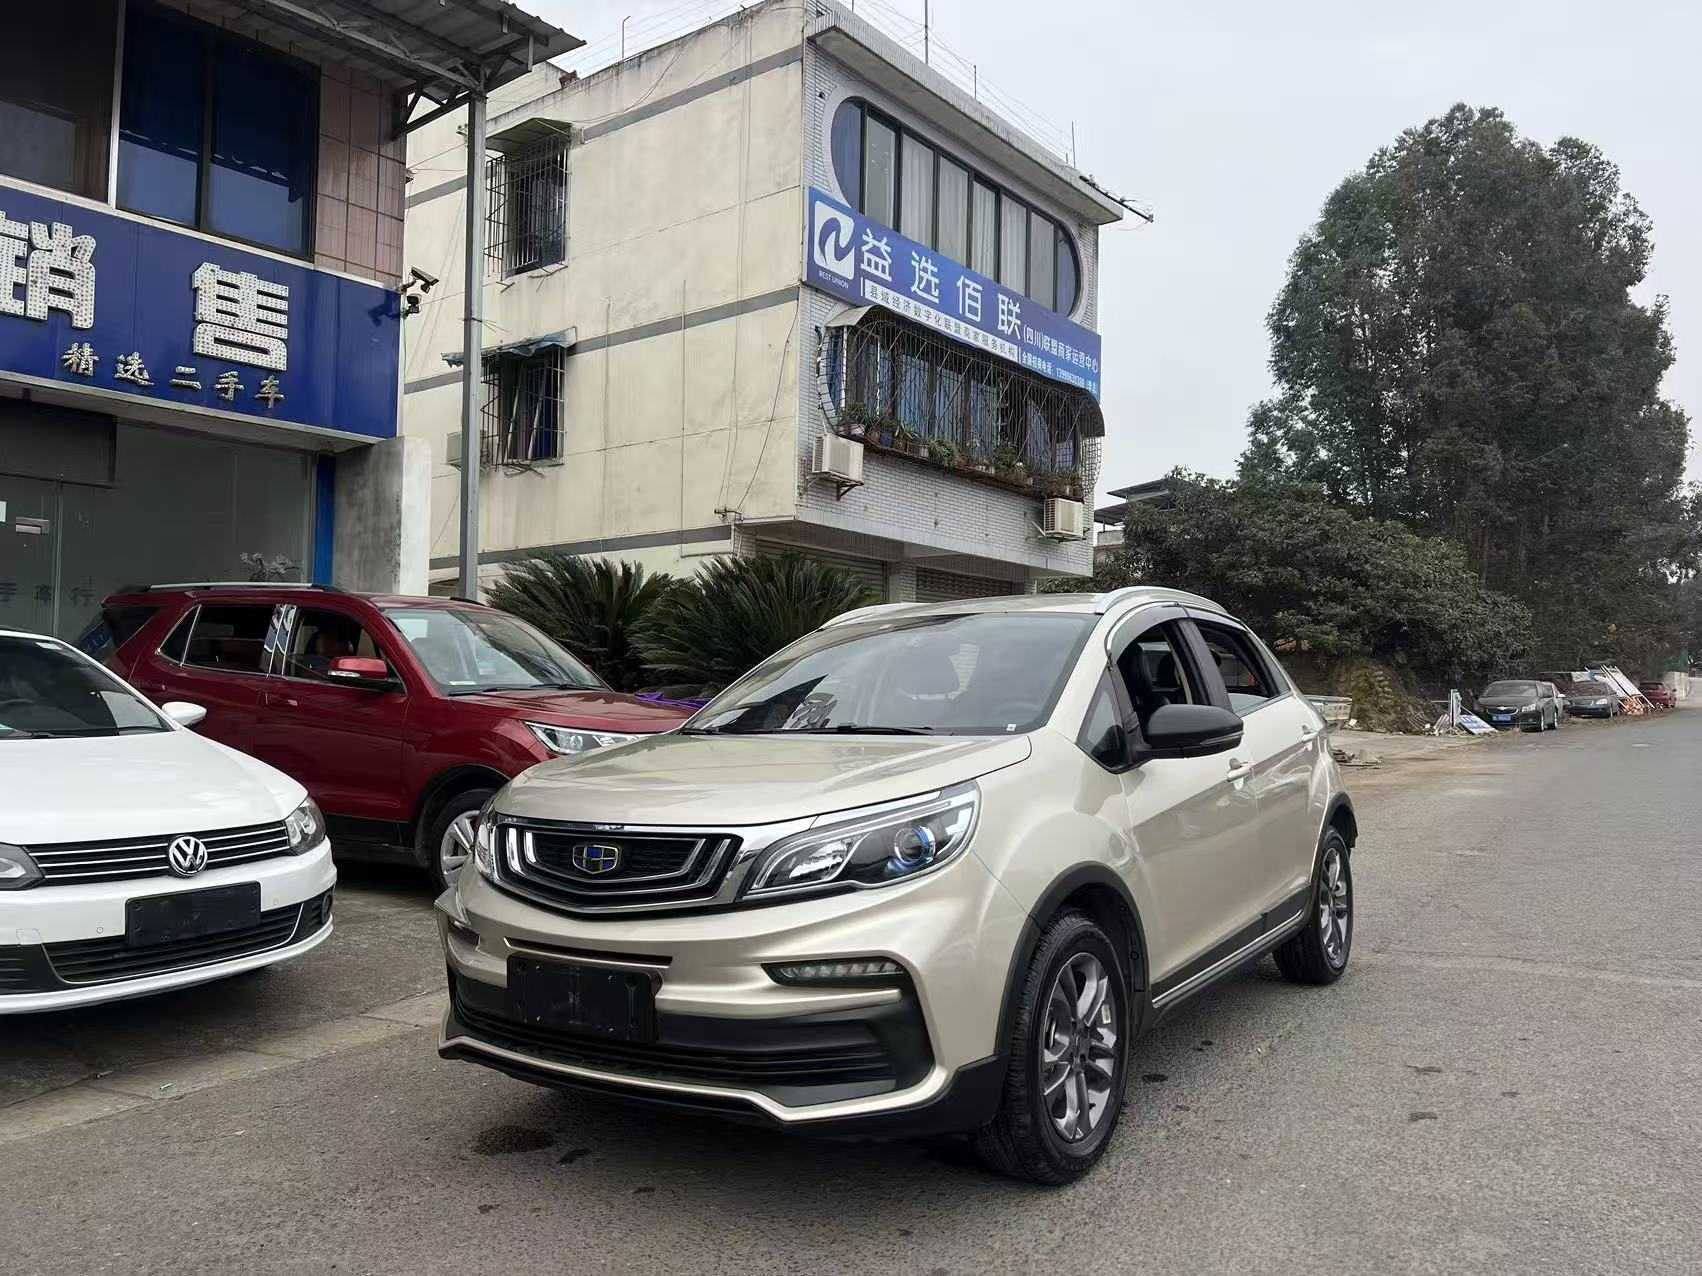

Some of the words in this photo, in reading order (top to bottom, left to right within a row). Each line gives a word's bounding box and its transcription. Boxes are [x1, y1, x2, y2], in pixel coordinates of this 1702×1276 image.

[0, 211, 289, 371] 销售
[860, 228, 1021, 341] 益选佰联
[61, 342, 286, 409] 精选二手车
